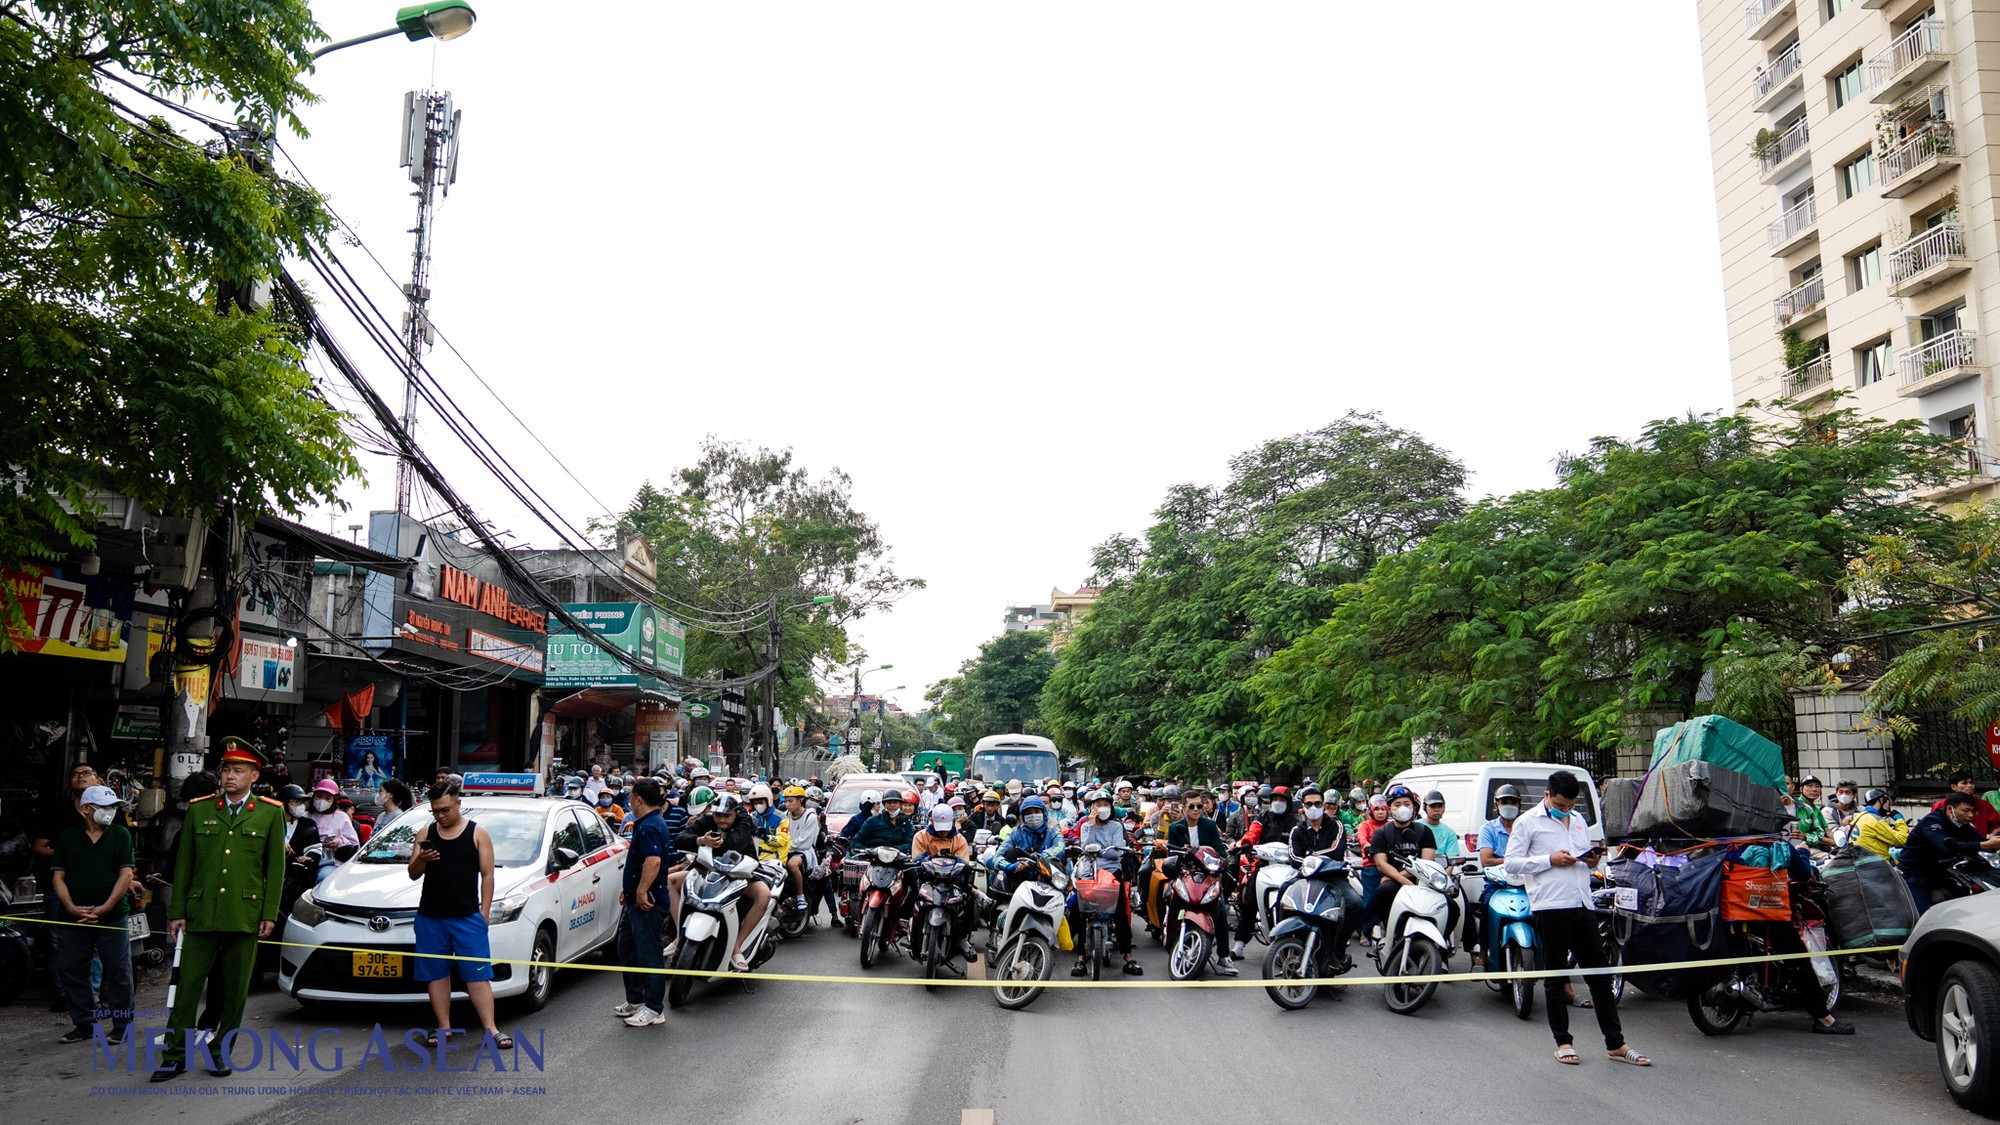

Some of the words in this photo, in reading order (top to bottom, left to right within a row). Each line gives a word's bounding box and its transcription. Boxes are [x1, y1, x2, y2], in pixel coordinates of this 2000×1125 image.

[440, 564, 479, 609] NAM
[479, 582, 508, 620] ANH
[367, 954, 389, 964] 30E
[358, 965, 397, 976] 974.65
